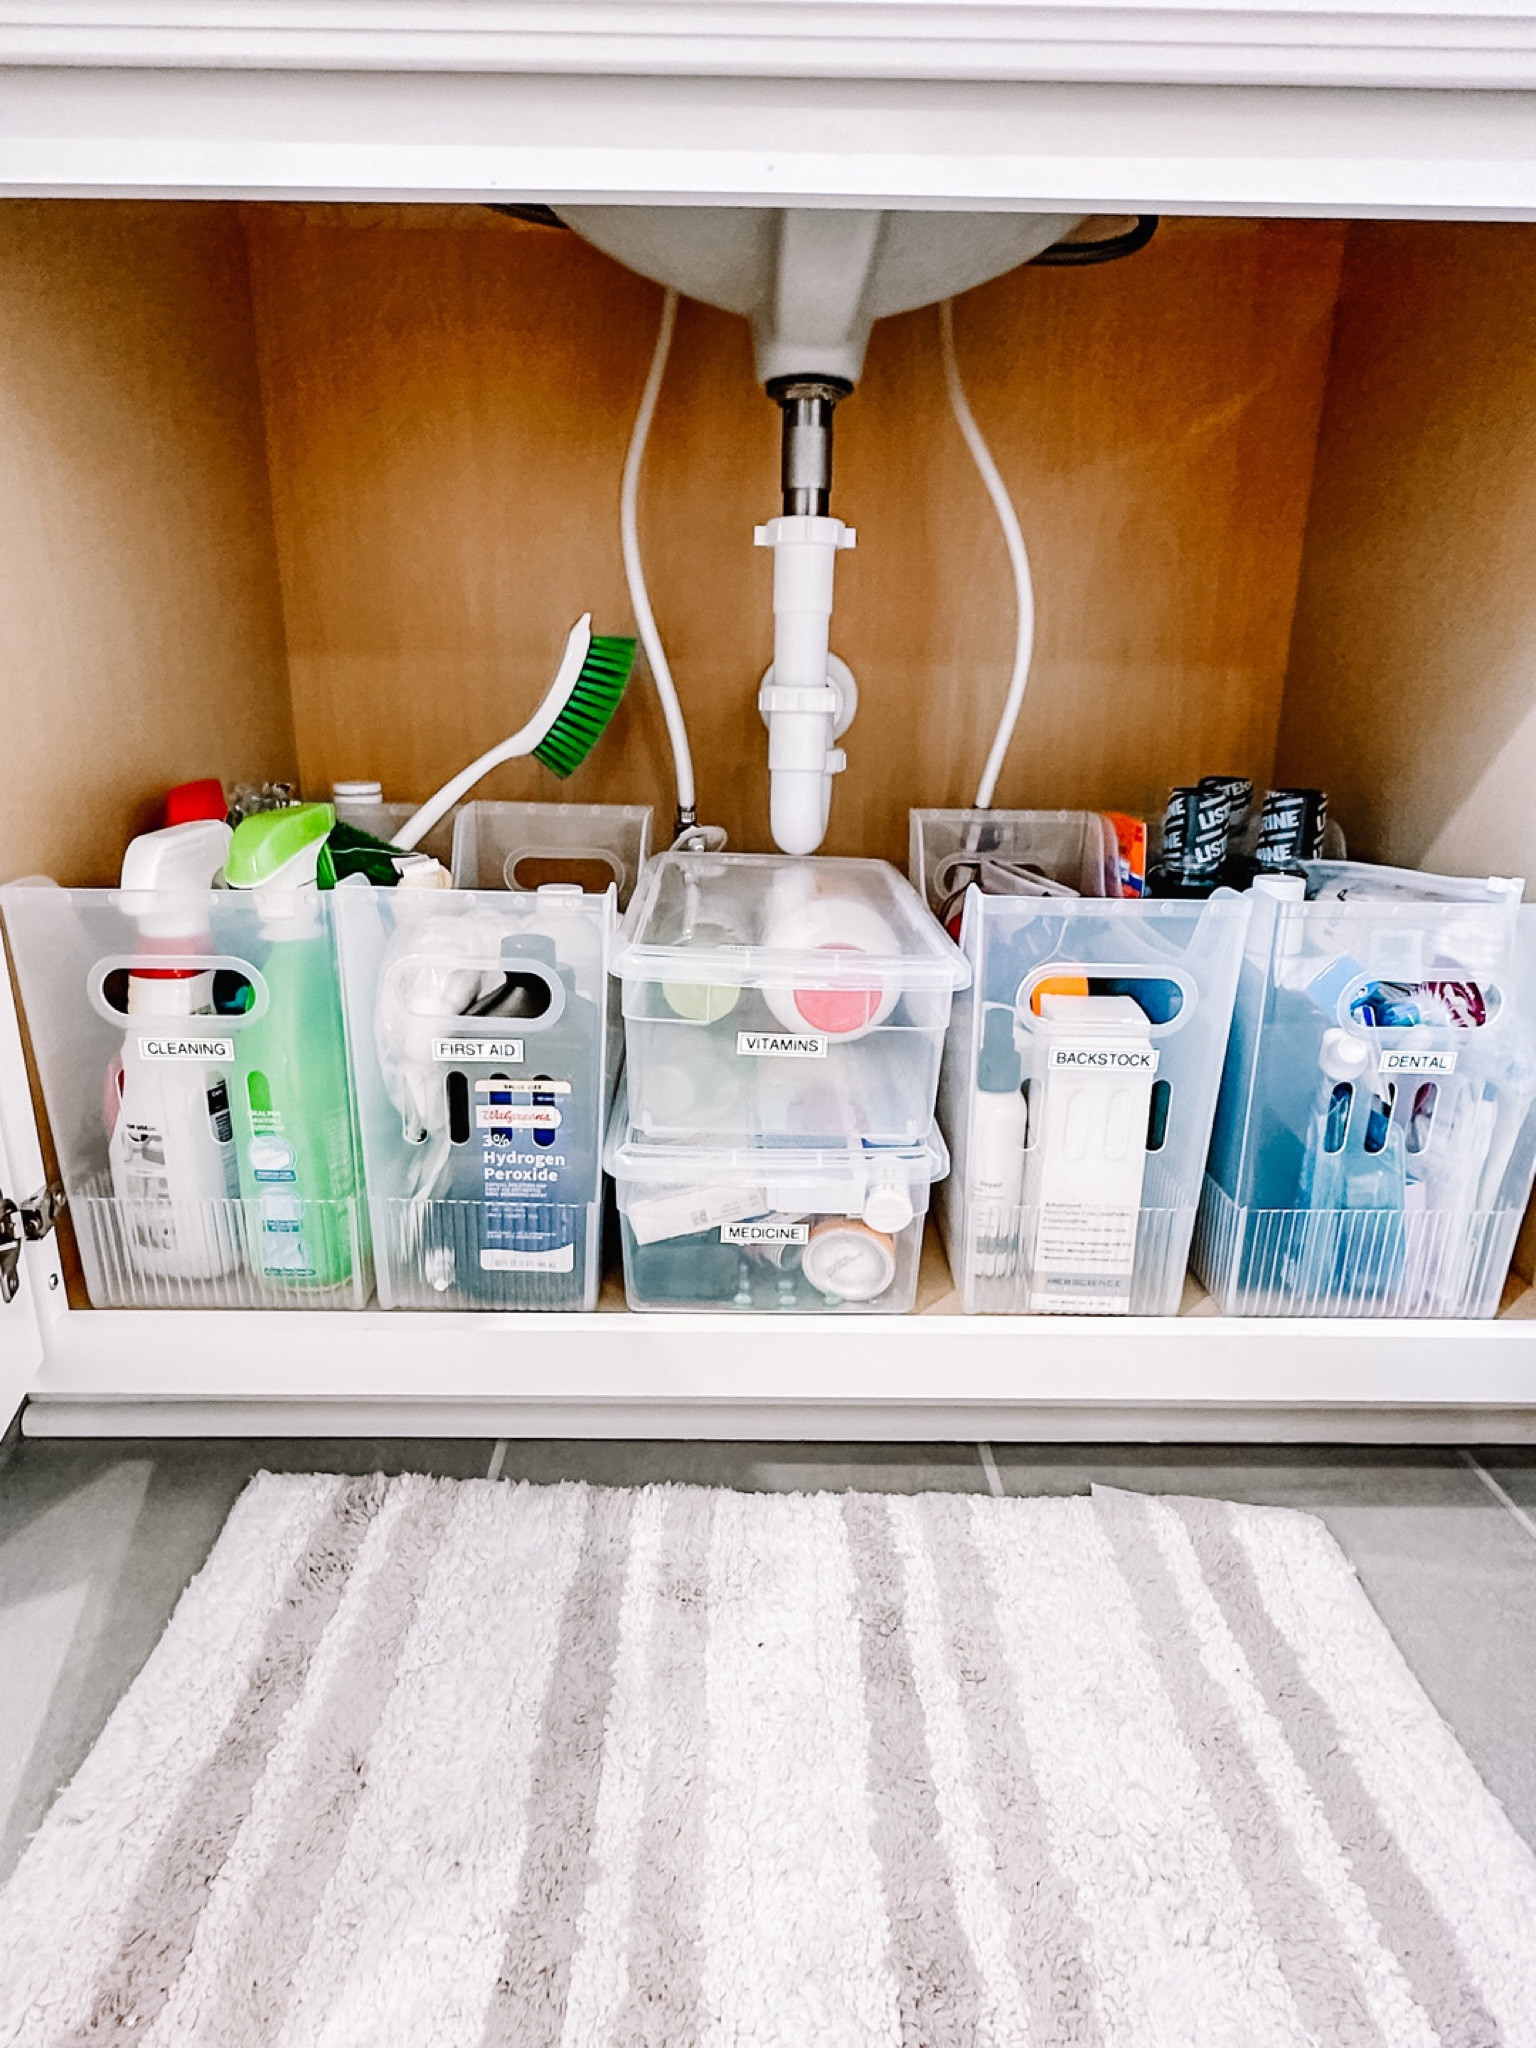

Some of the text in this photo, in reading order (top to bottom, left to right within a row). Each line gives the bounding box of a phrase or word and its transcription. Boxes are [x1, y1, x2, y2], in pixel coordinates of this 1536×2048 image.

[147, 1041, 226, 1056] CLEANING
[440, 1043, 516, 1056] FIRST AID
[746, 1037, 819, 1052] VITAMINS
[1056, 1051, 1151, 1067] BACKSTOCK
[1387, 1054, 1447, 1069] DENTAL
[482, 1134, 510, 1147] 3%
[483, 1150, 566, 1168] Hydrogen
[484, 1166, 559, 1183] Peroxide
[729, 1226, 800, 1240] MEDICINE
